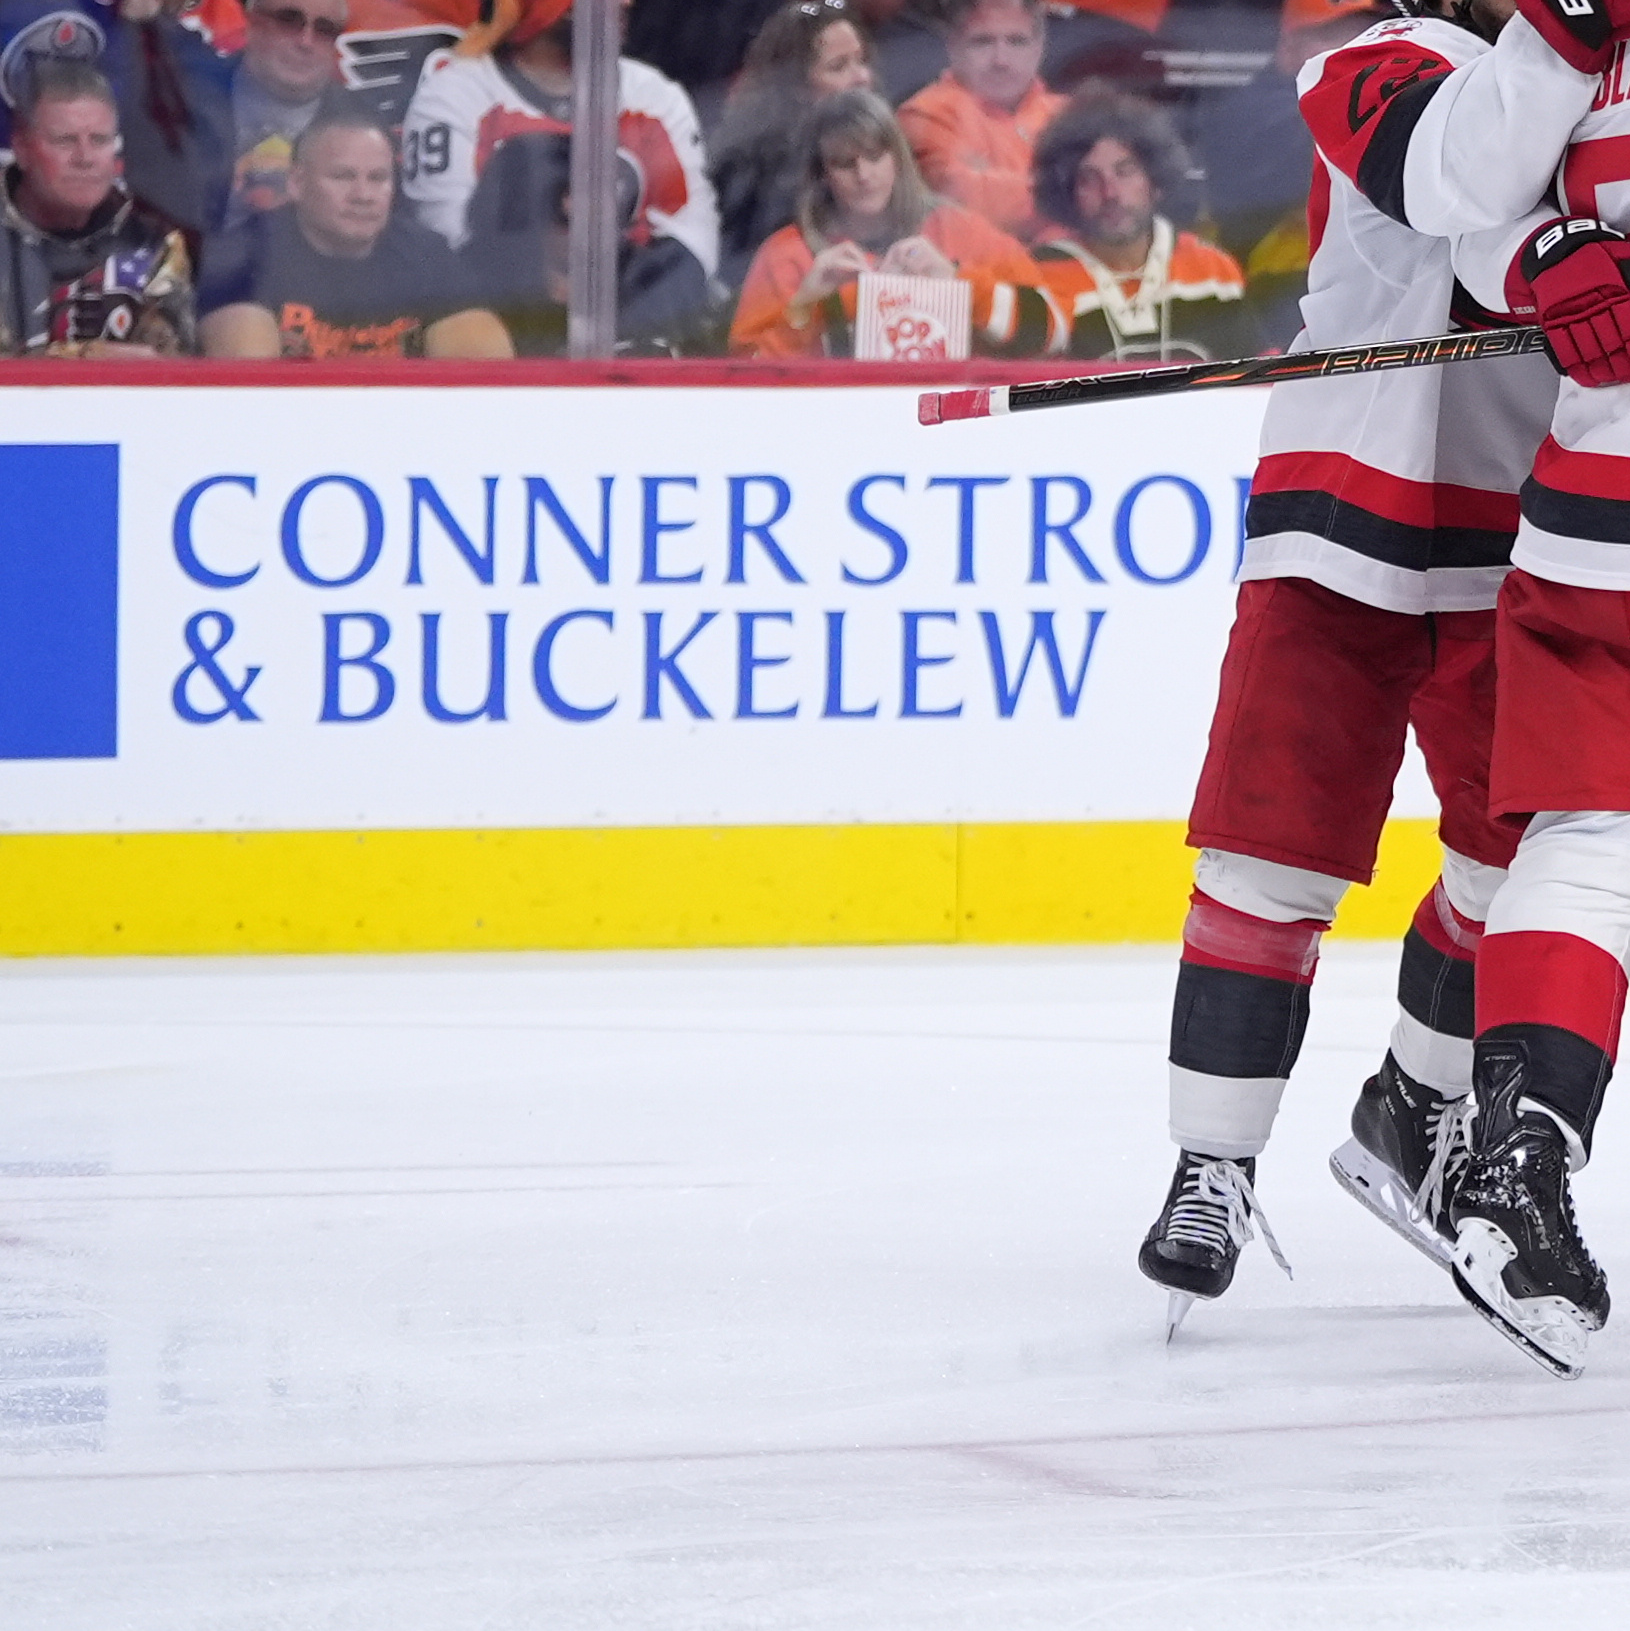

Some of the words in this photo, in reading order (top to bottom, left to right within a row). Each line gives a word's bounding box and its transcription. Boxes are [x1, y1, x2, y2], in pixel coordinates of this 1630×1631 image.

[171, 473, 809, 590] CONNER
[171, 609, 264, 725] &
[317, 609, 1108, 725] BUCKELEW
